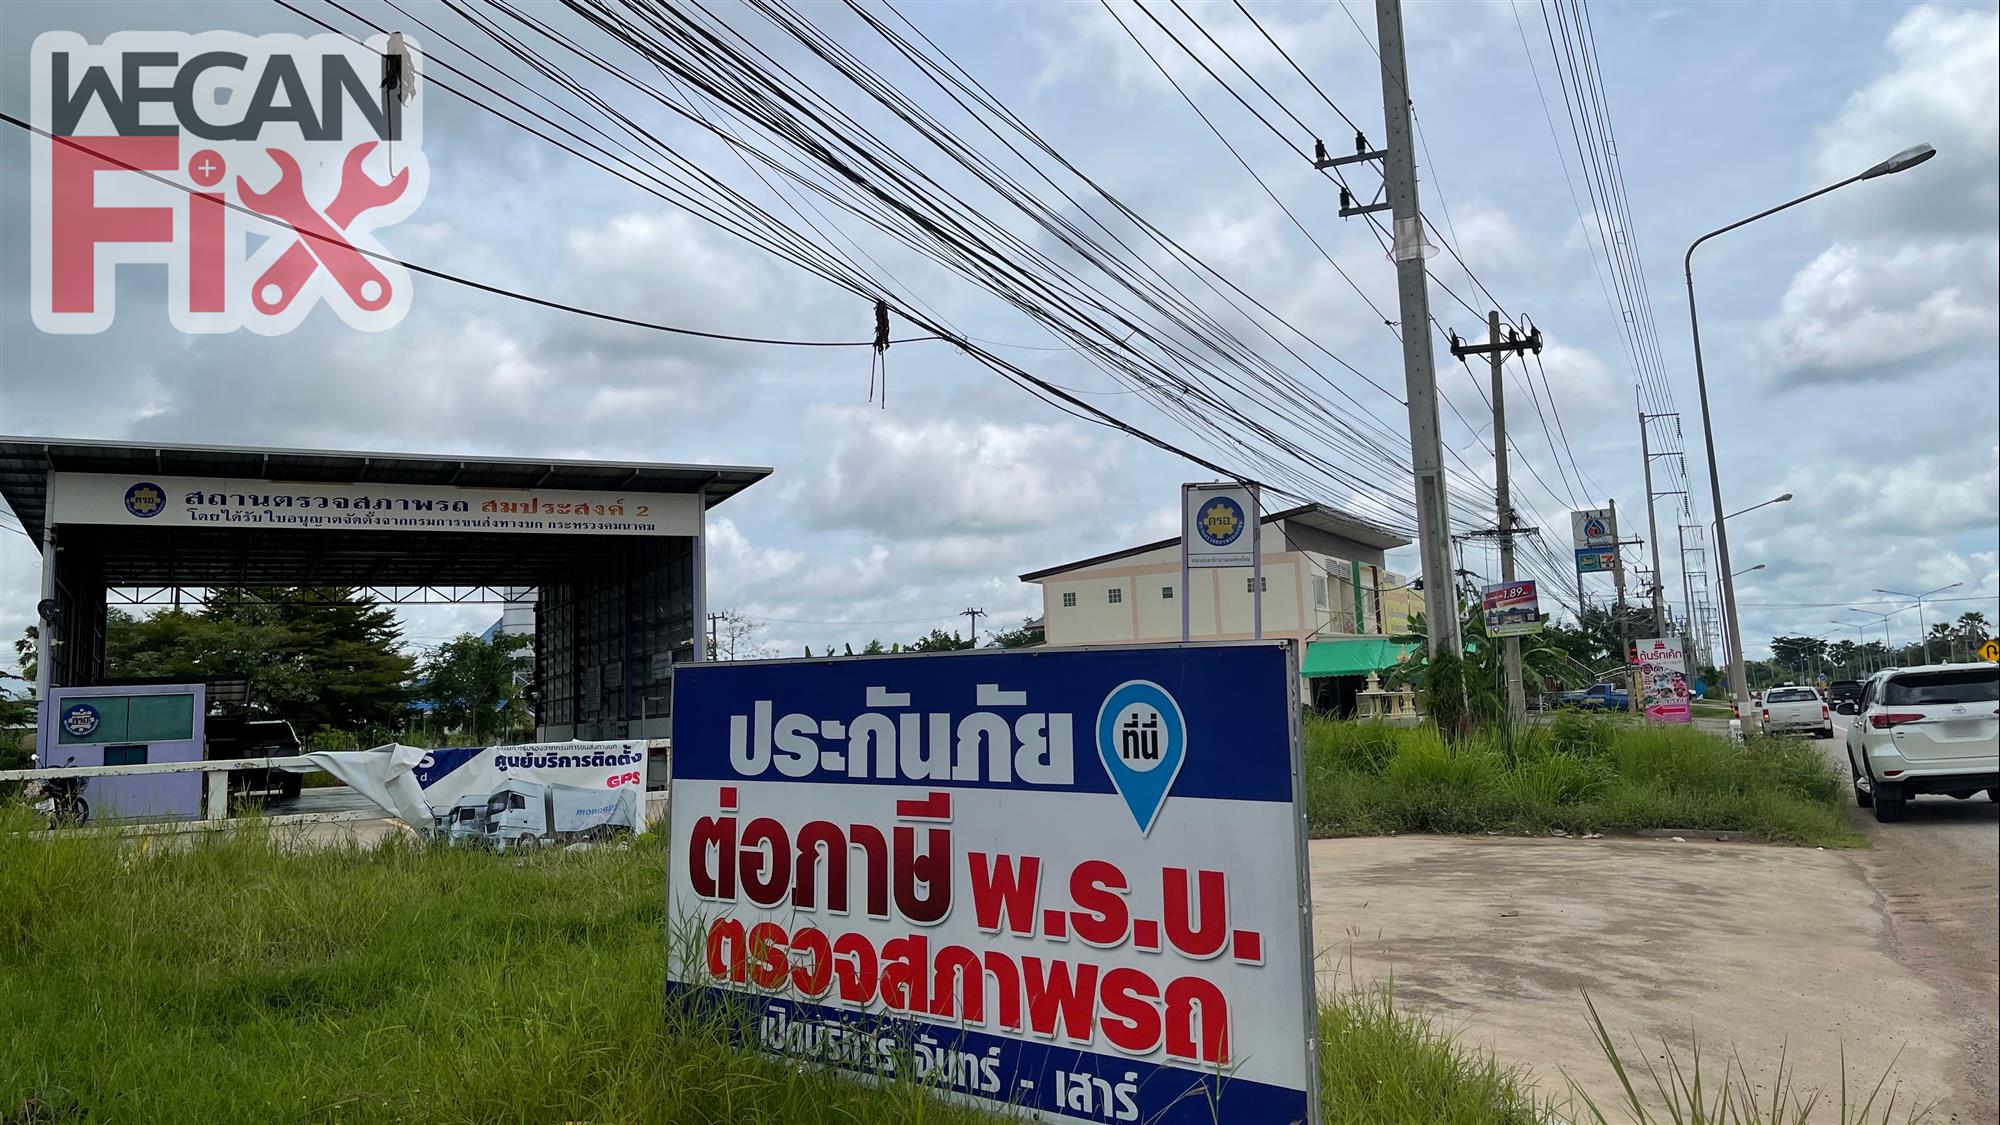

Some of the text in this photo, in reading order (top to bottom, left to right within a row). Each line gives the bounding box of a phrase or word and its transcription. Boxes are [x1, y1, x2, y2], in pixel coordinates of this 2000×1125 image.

[185, 490, 469, 513] สถานตรวจสภาพรถ
[481, 497, 625, 517] สมประสงค์
[635, 505, 650, 517] 2
[1503, 586, 1523, 600] 1.89
[495, 745, 642, 772] ศูนย์บริการติดตั้ง
[730, 684, 1075, 785] ประกันภัย
[1122, 711, 1160, 761] ที่นี่
[606, 771, 641, 788] GPS
[690, 787, 953, 924] ต่อภาษี
[968, 852, 1264, 966] พ.ร.บ.
[706, 917, 1232, 1067] ตรวจสภาพรถ
[1055, 1070, 1140, 1122] เสาร์
